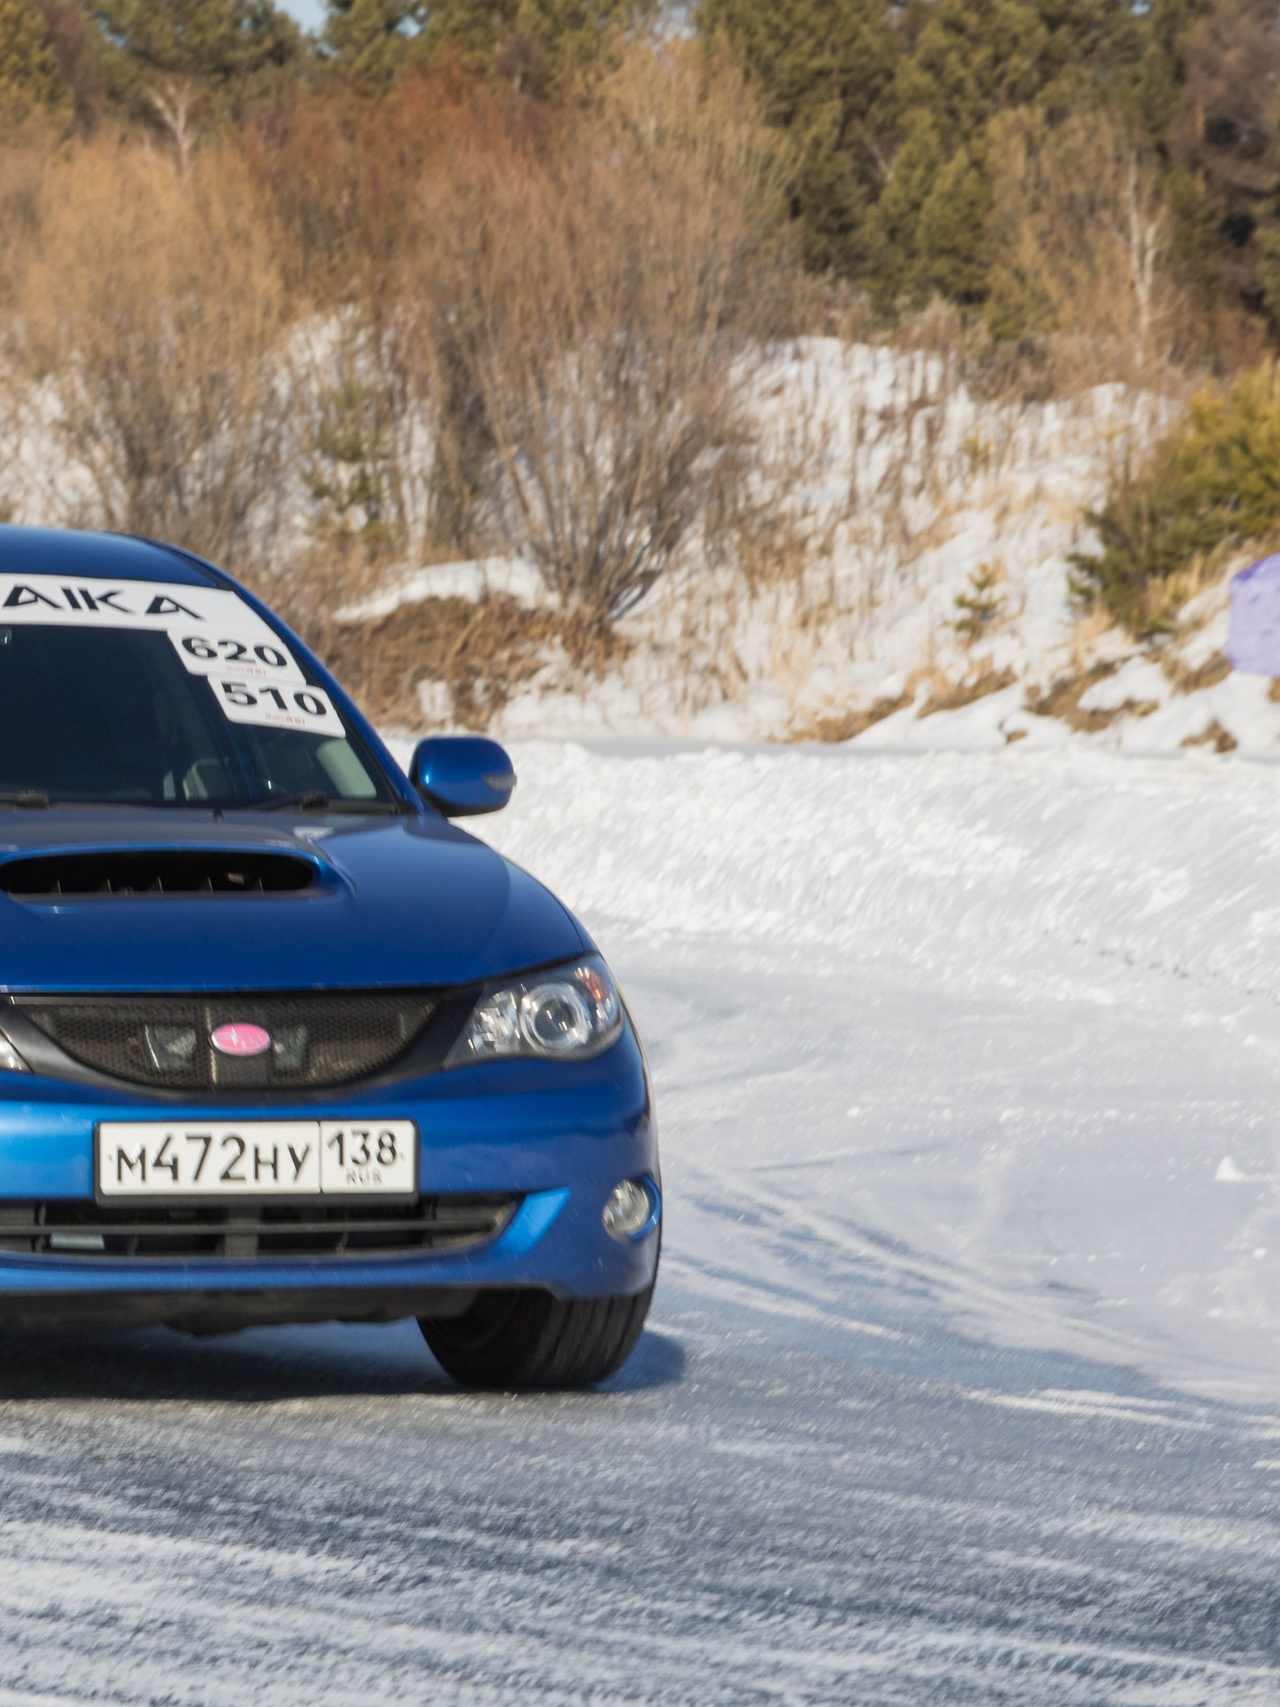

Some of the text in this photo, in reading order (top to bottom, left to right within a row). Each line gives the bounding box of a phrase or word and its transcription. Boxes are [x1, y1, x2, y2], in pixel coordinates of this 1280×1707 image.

[181, 636, 288, 667] 620
[221, 680, 328, 716] 510
[116, 1129, 399, 1183] М472НУ 138
